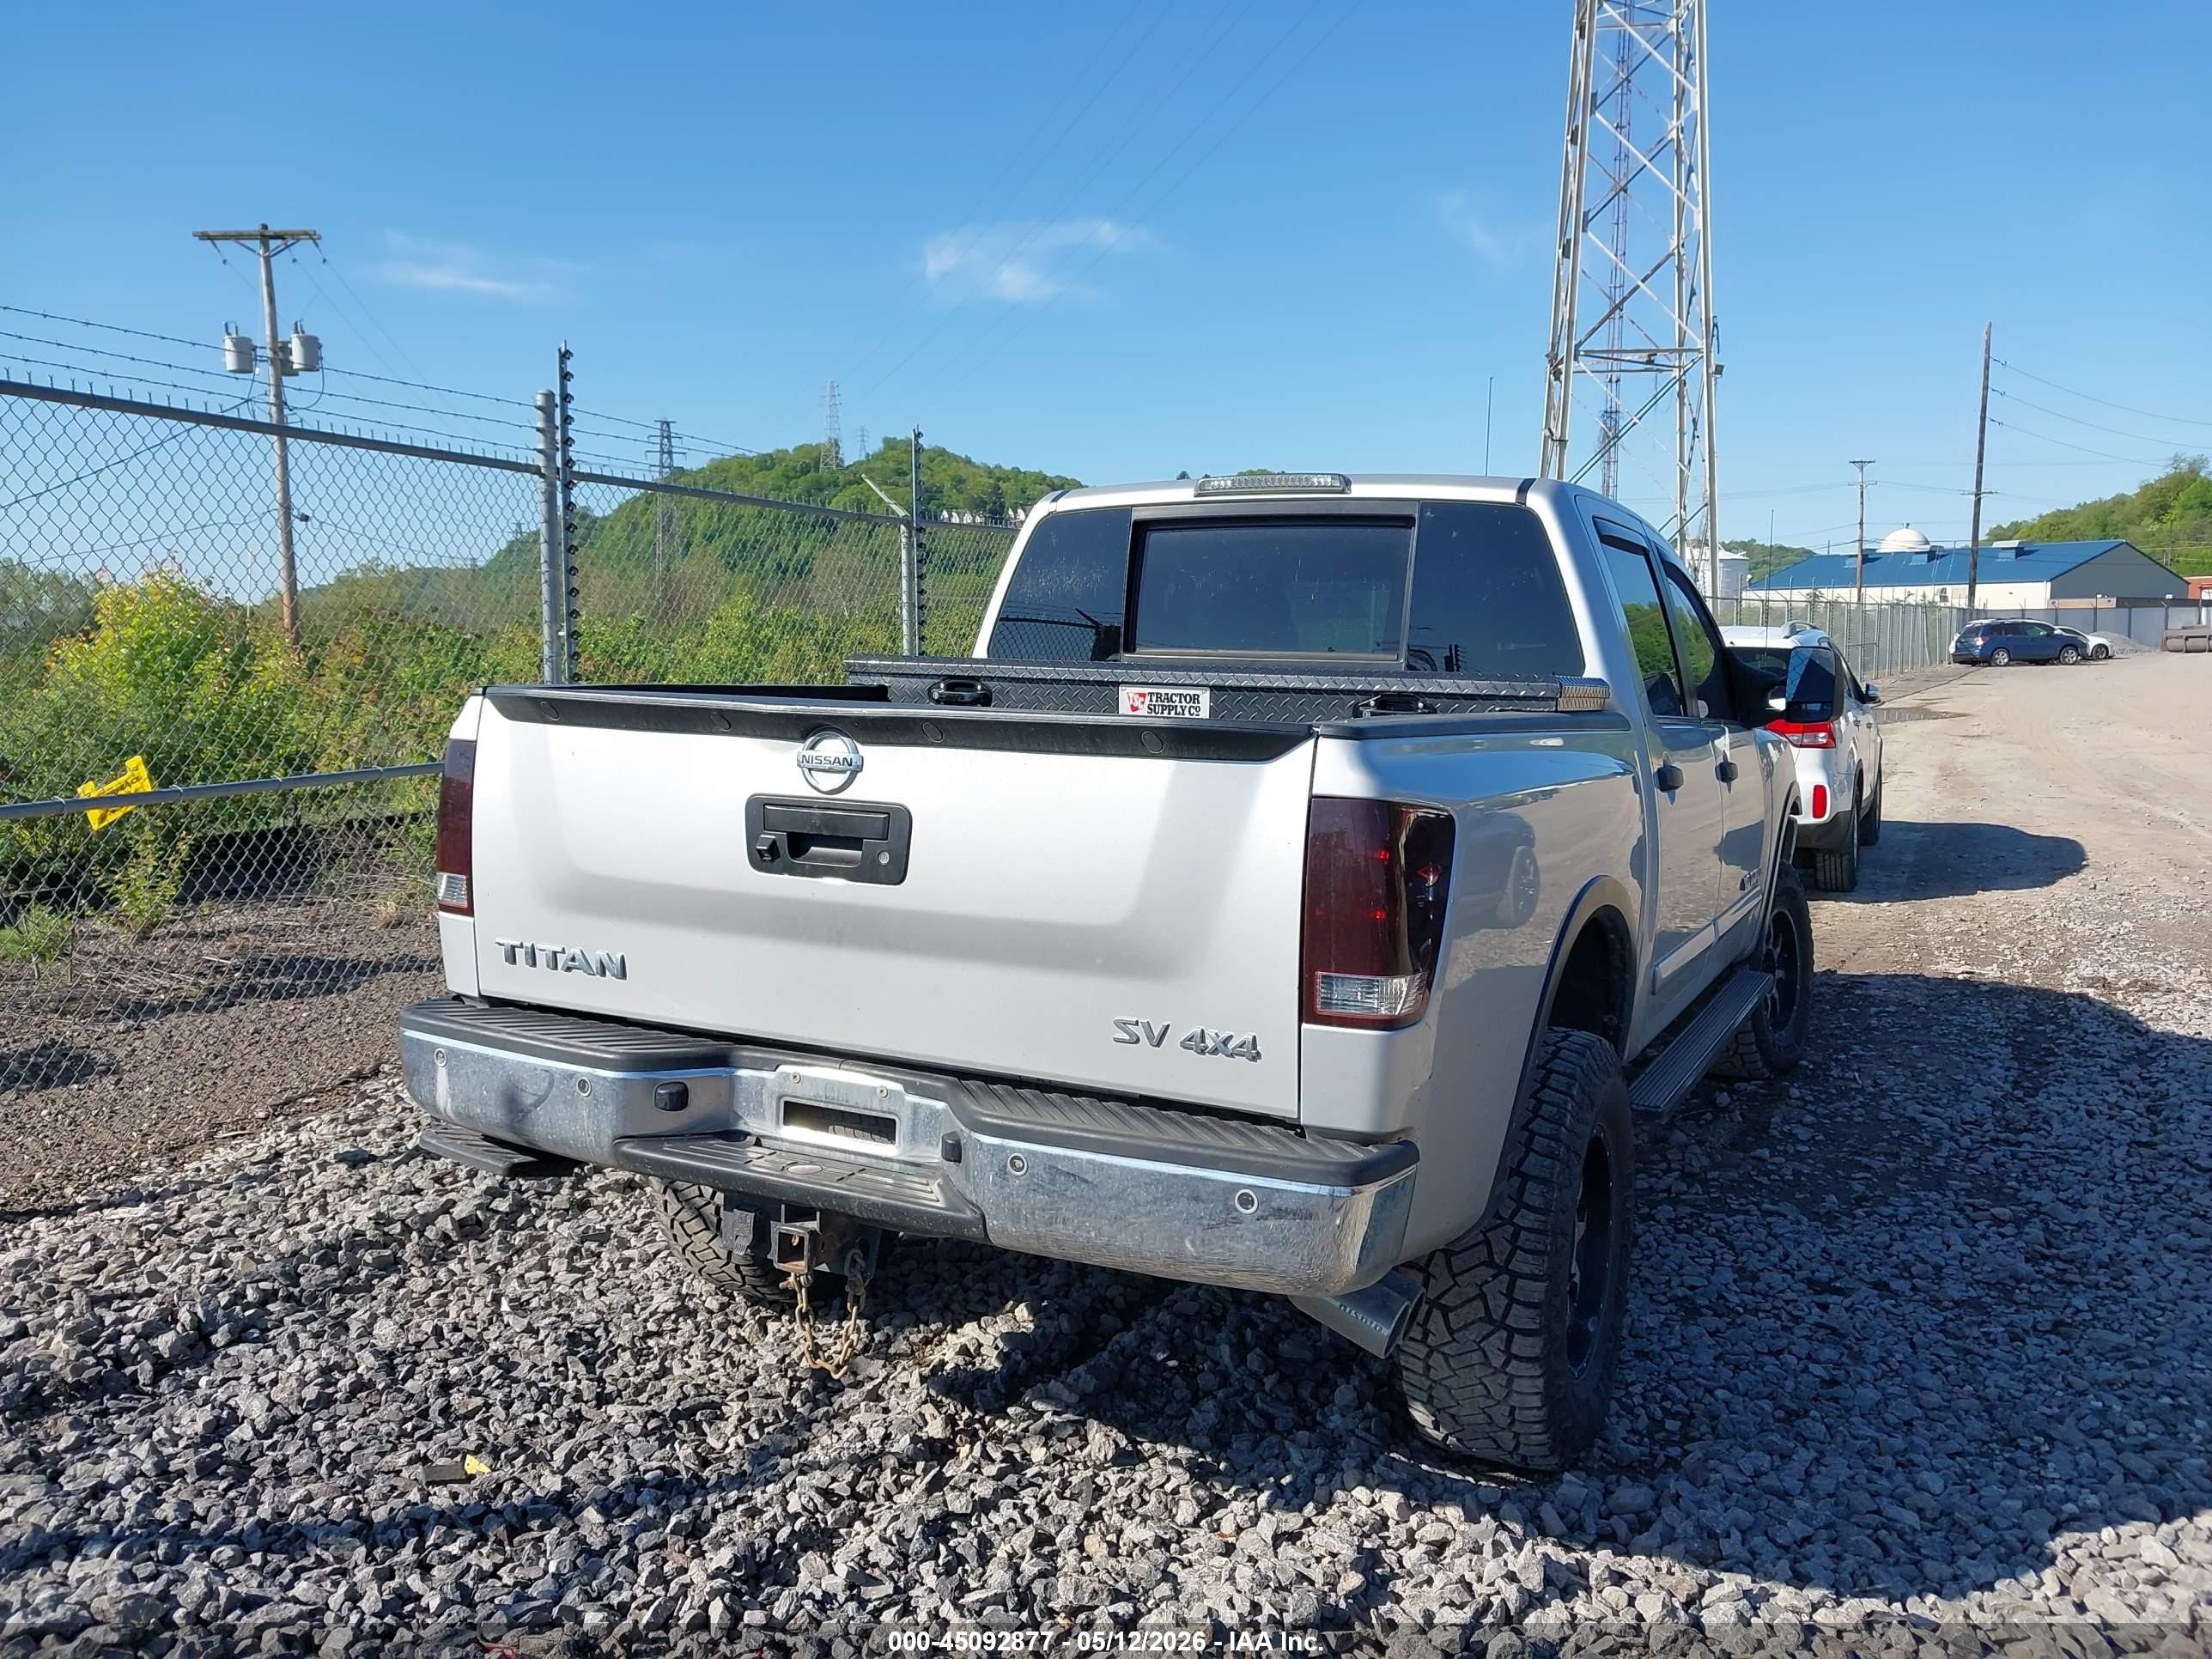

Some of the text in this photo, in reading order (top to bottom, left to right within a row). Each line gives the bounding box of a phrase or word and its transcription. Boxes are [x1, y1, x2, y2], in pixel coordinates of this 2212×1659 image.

[1127, 692, 1145, 709] TSC
[1147, 692, 1200, 705] TRACTOR
[1146, 703, 1188, 716] SUPPLY
[801, 754, 854, 769] NISSAN
[495, 937, 628, 981] TITAN
[1112, 1016, 1262, 1063] SV 4X4
